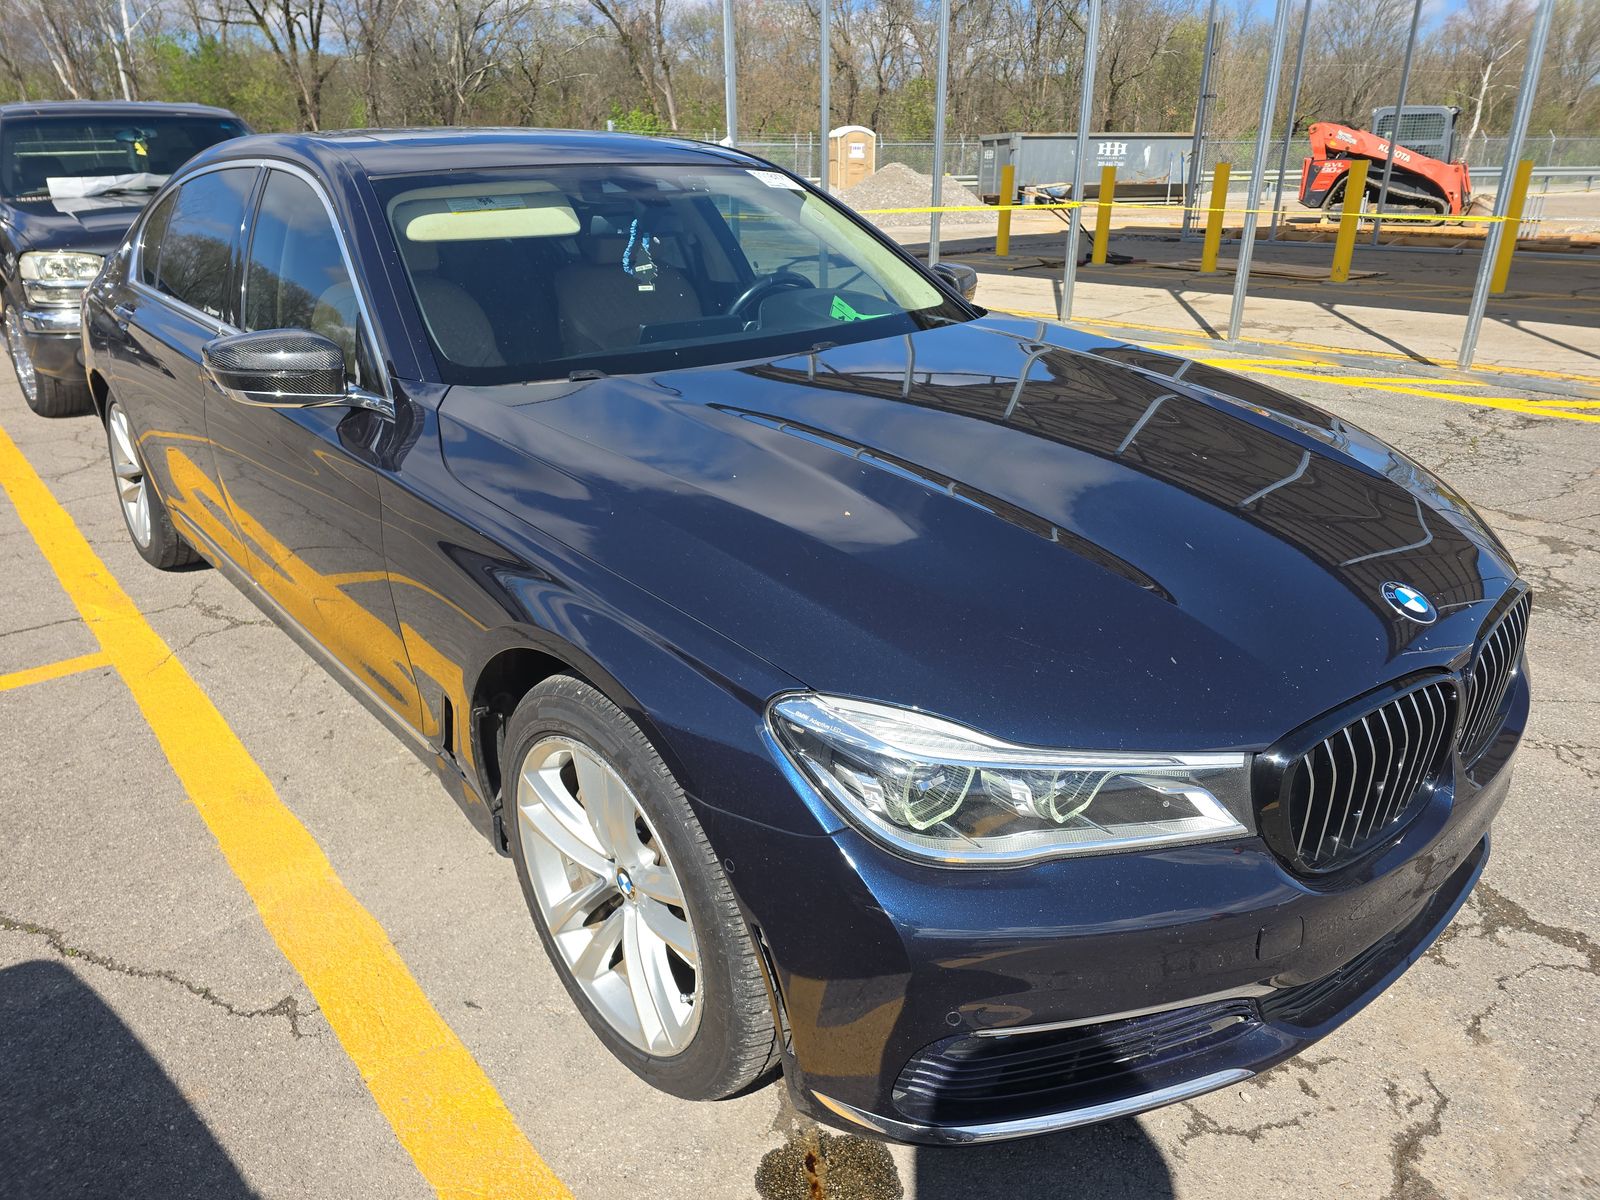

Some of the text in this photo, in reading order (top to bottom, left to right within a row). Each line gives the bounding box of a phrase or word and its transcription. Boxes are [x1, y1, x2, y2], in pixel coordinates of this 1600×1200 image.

[1377, 143, 1411, 162] KUOTA
[795, 711, 809, 720] BMW
[809, 718, 830, 729] Adaptive
